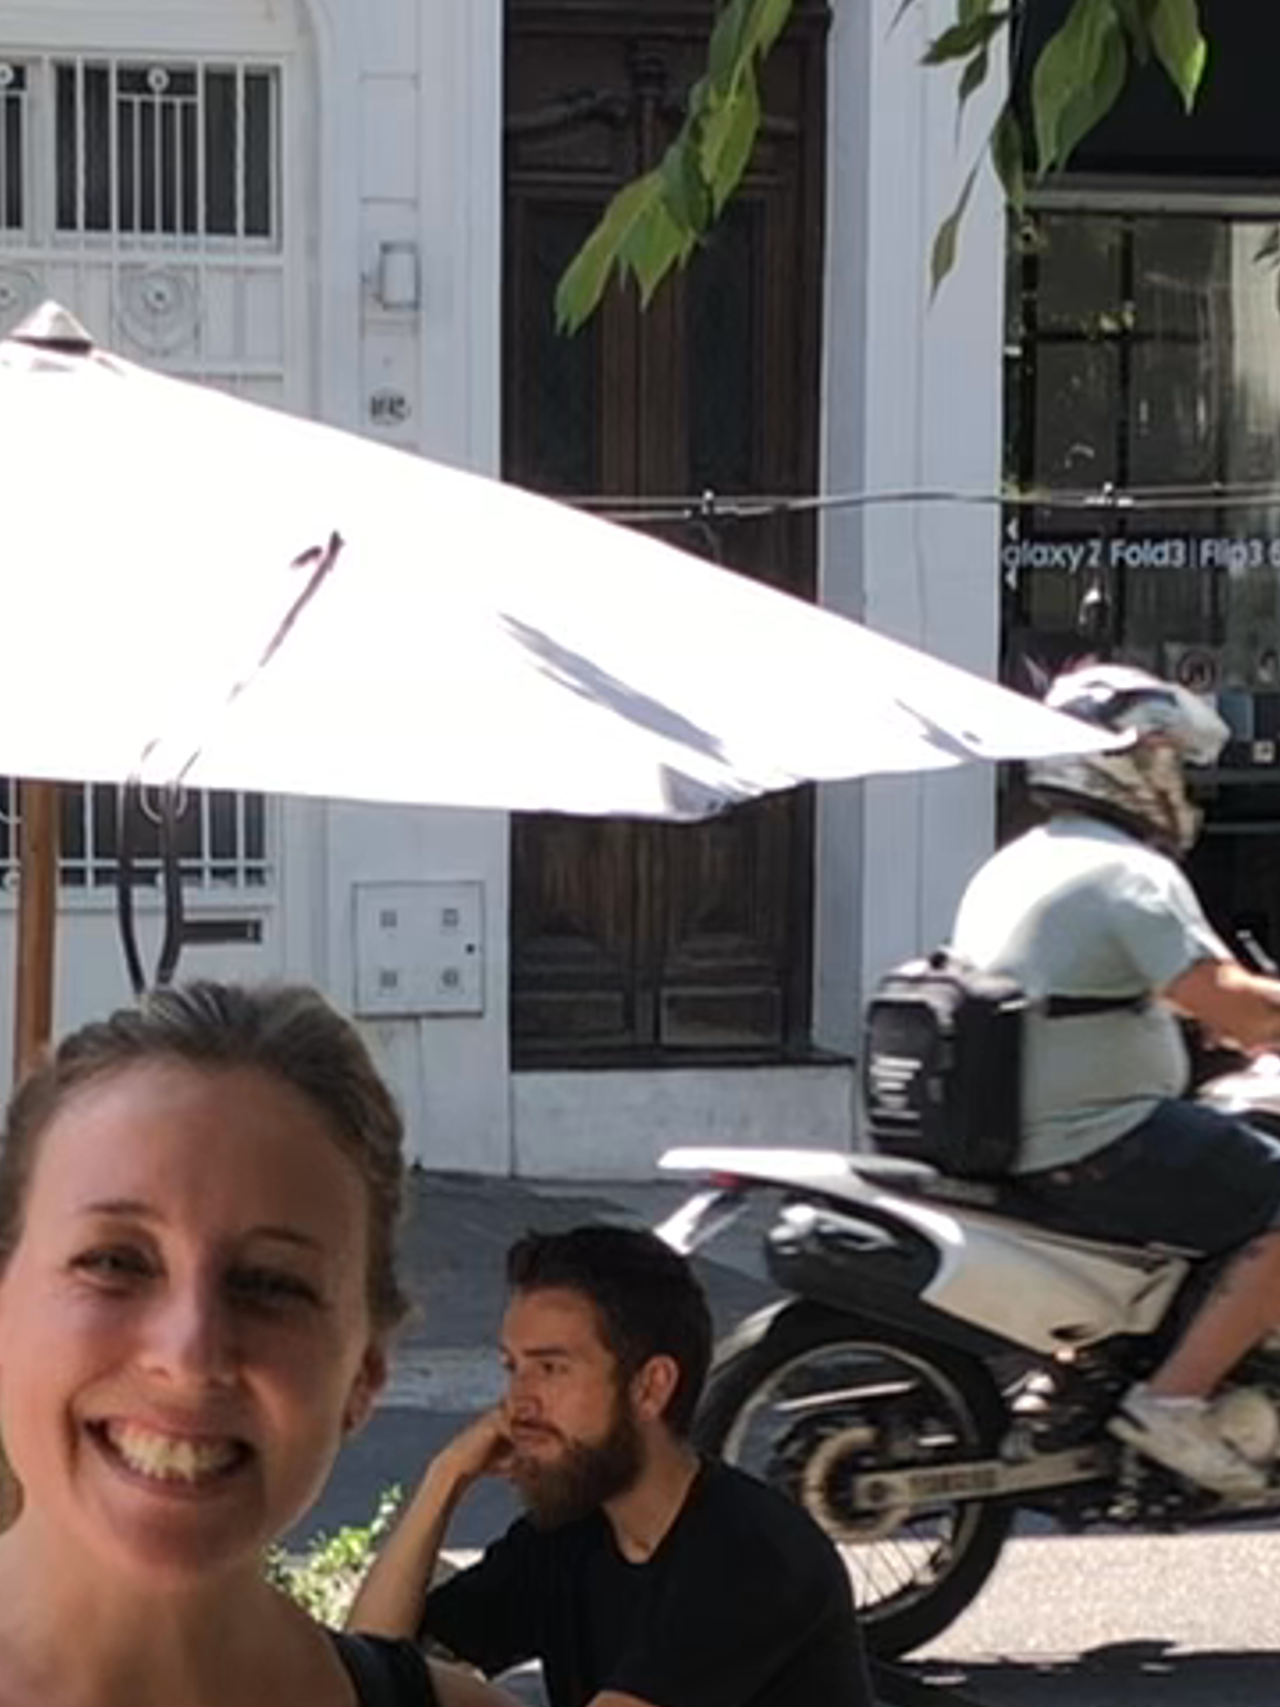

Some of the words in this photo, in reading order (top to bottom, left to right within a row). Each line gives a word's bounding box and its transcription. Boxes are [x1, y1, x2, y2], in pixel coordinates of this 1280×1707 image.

[1002, 539, 1084, 574] alaxy
[1109, 538, 1187, 568] Fold3
[1199, 538, 1265, 577] Flip3
